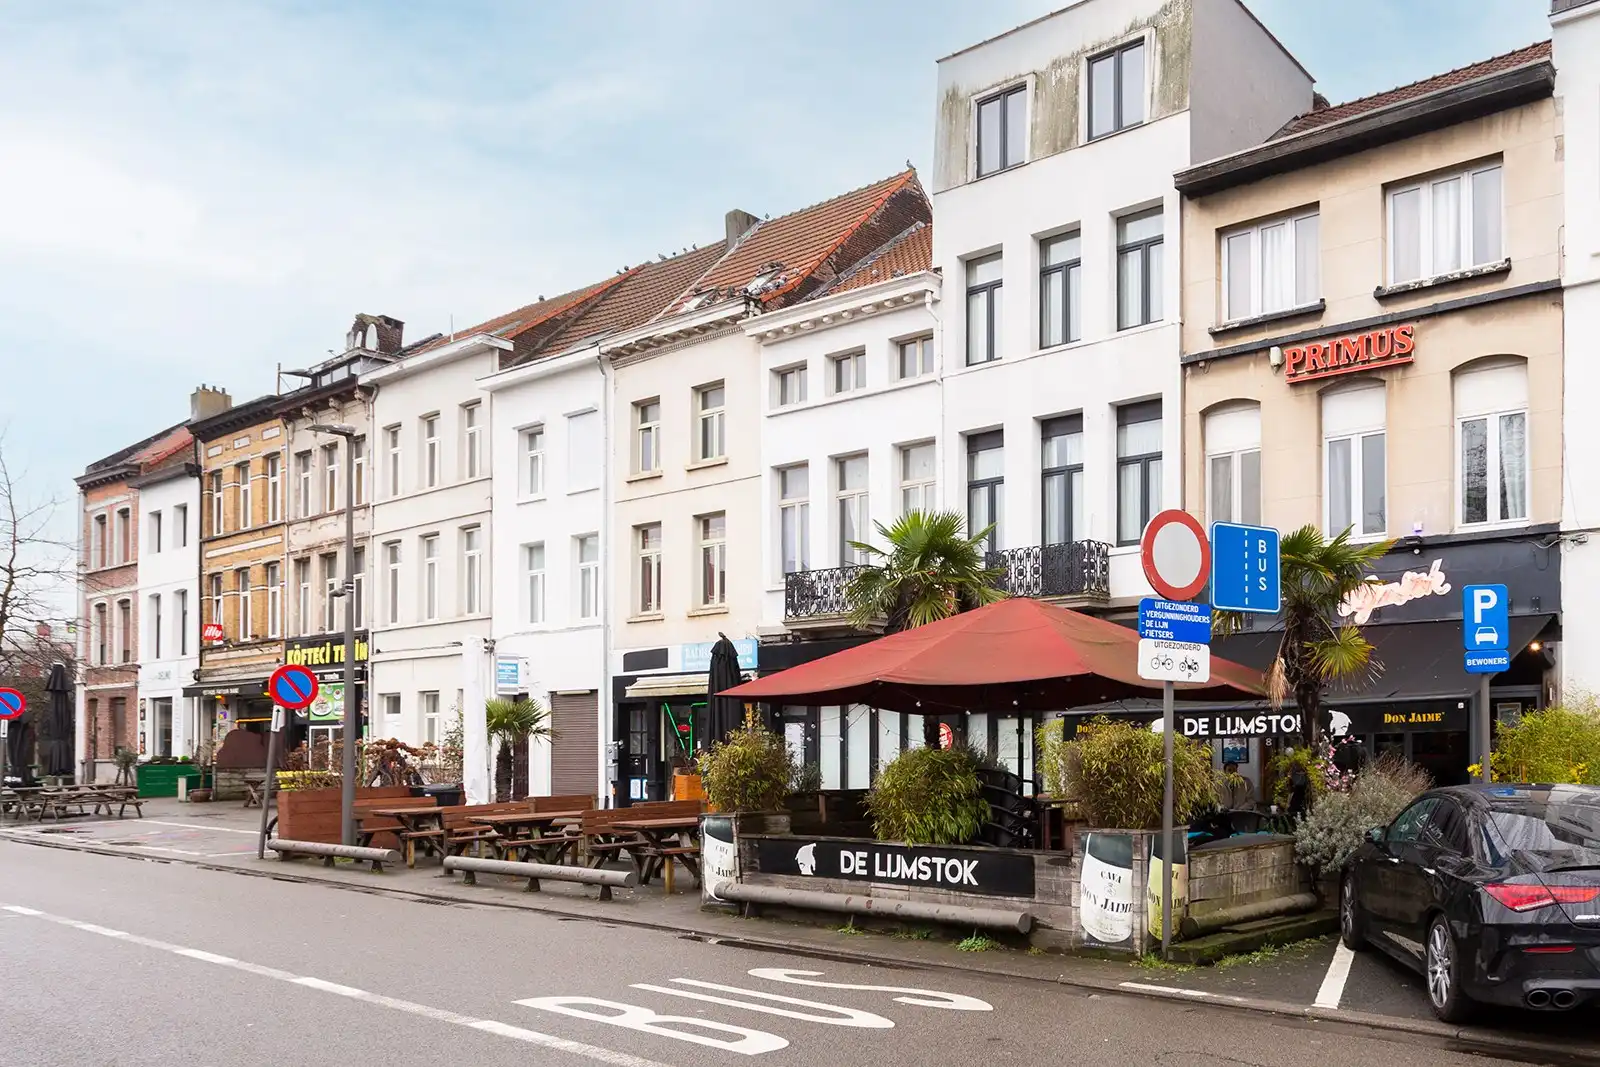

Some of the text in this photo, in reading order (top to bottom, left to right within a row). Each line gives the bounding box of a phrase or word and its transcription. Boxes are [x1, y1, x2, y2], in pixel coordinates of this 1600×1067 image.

[1284, 323, 1414, 376] PRIMUS
[1258, 539, 1267, 591] BUS
[1154, 601, 1199, 612] UITGEZONDERD
[1473, 589, 1497, 624] P
[1145, 611, 1210, 623] VERGUNNINGHOUDERS
[1145, 620, 1154, 628] DE
[1155, 621, 1169, 629] LIJN
[204, 625, 222, 639] illy
[1145, 629, 1174, 639] FIETSERS
[1154, 641, 1201, 651] UITGEZONDERD
[1466, 656, 1508, 667] BEWONERS
[1183, 717, 1209, 736] DE
[1265, 737, 1273, 746] 8
[840, 849, 980, 886] DE LIJMSTOK
[1100, 870, 1122, 884] CAVA
[510, 967, 994, 1056] BUS
